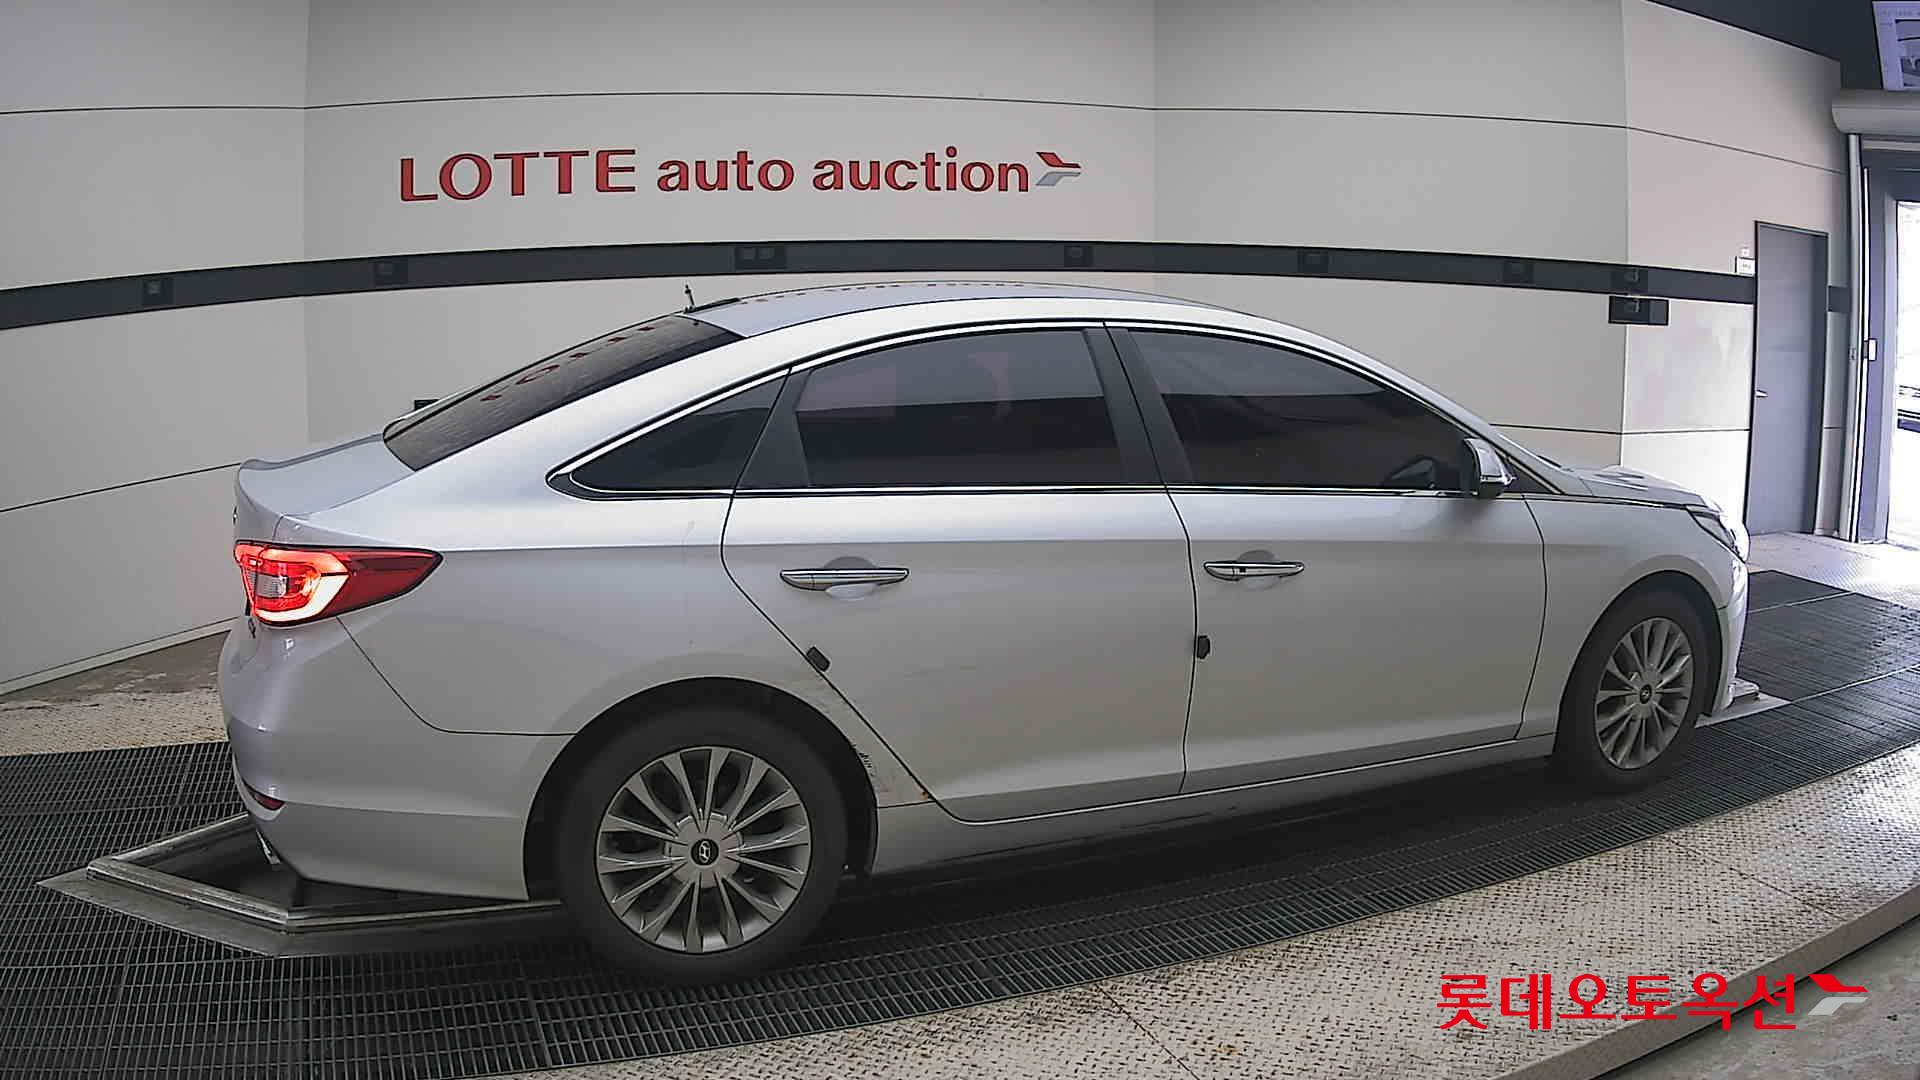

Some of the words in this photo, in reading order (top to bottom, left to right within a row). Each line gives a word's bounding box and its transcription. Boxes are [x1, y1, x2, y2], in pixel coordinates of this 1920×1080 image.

[400, 149, 636, 202] LOTTE
[657, 150, 795, 192] auto
[813, 146, 1029, 192] auction
